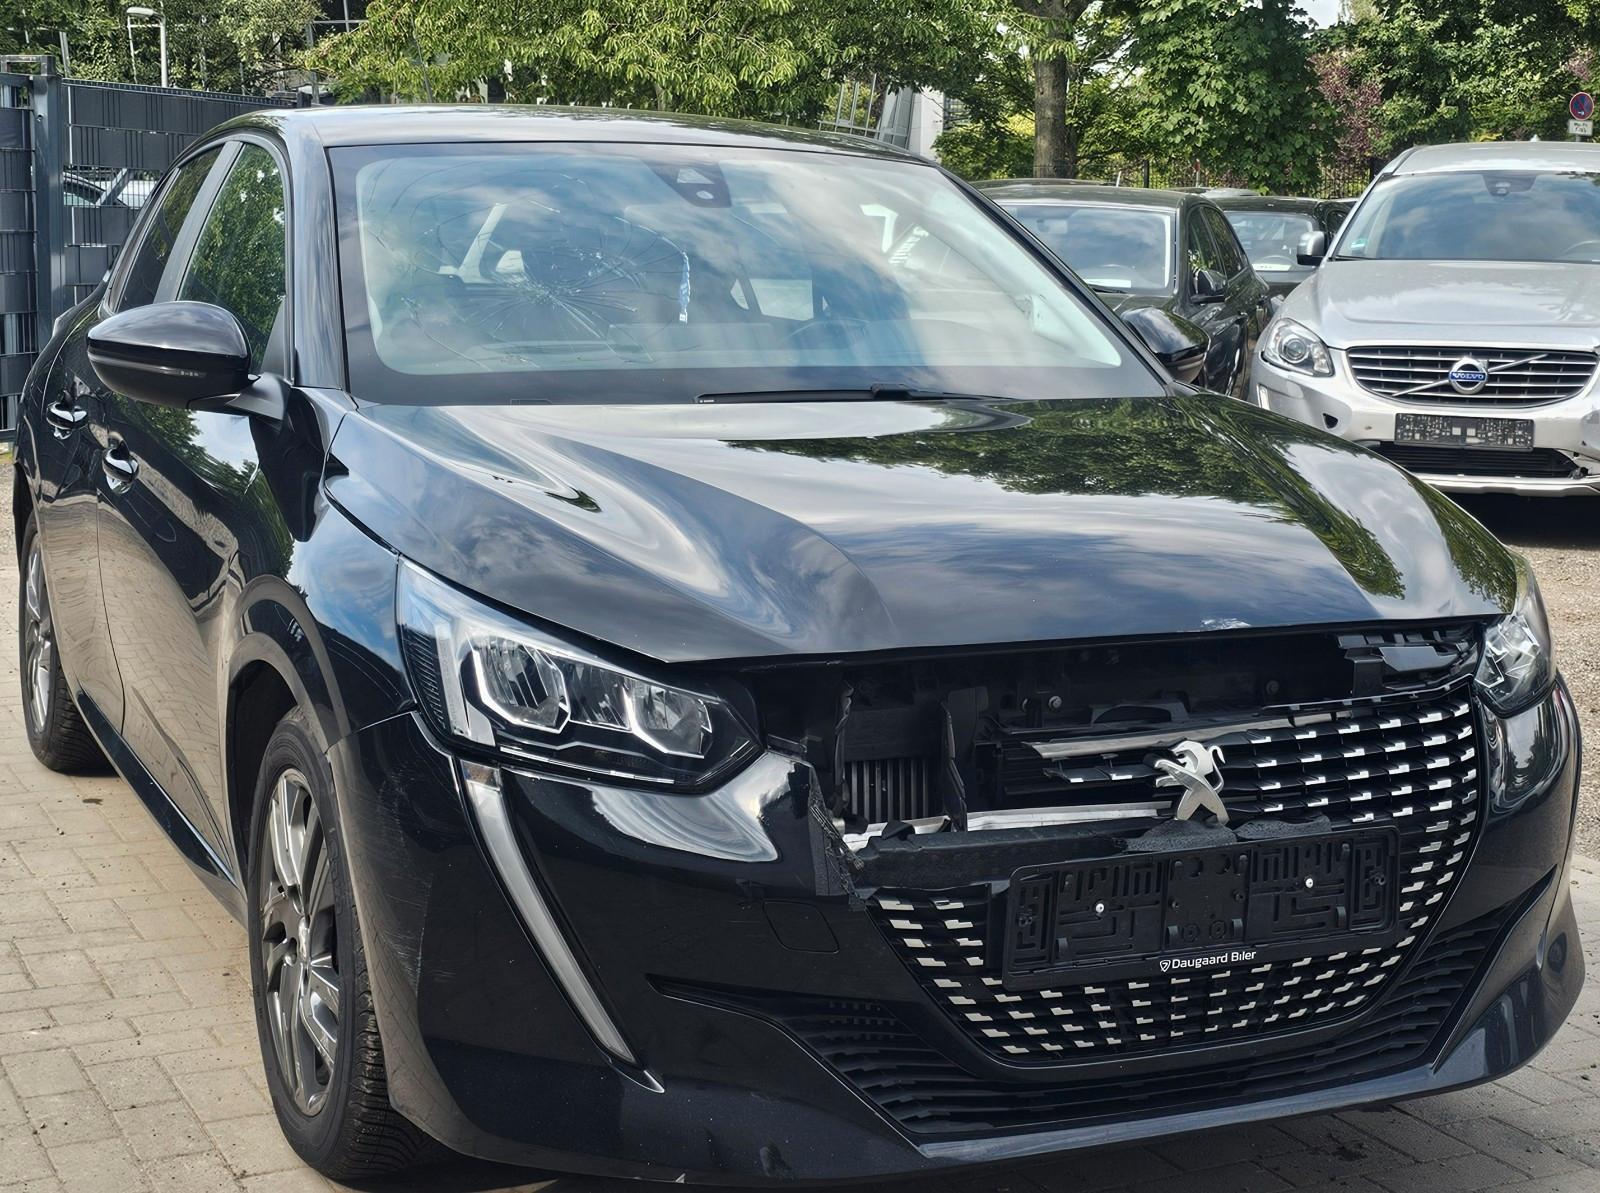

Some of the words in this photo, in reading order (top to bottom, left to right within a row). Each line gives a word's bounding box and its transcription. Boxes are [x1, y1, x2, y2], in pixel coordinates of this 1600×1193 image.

[1452, 372, 1484, 380] VOLVO
[1172, 953, 1228, 968] Daugaard
[1231, 951, 1257, 962] Biler
